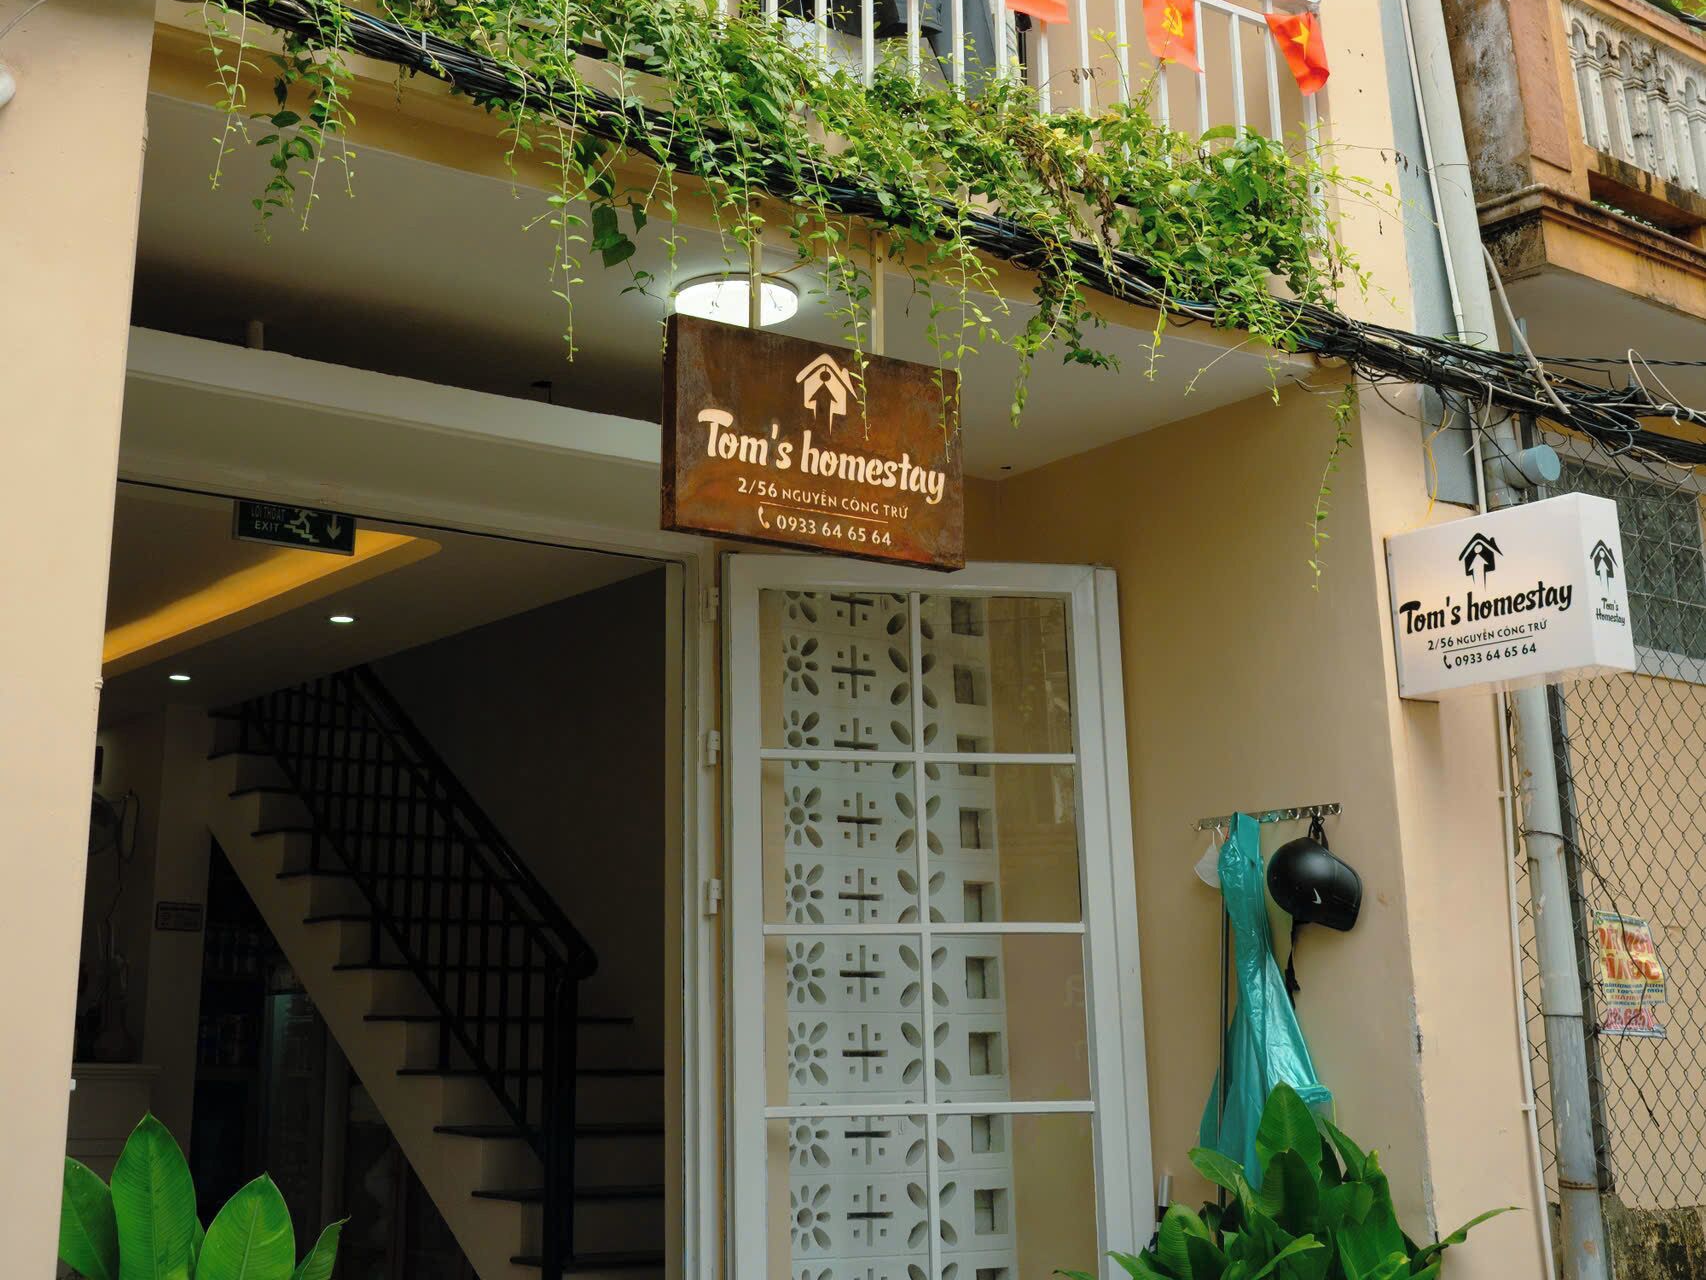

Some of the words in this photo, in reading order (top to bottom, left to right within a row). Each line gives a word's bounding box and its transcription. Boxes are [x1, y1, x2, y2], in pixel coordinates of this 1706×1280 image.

[697, 408, 794, 470] Tom's
[800, 430, 946, 505] homestay
[737, 477, 778, 499] 2/56
[841, 494, 879, 515] CÔNG
[254, 520, 280, 533] EXIT
[776, 513, 816, 535] 0933
[821, 521, 842, 539] 64
[847, 526, 867, 543] 65
[871, 529, 892, 547] 64
[1399, 596, 1461, 635] Tom's
[1467, 581, 1573, 622] homestay
[1601, 597, 1619, 612] Tom's
[1427, 636, 1454, 651] 2/56
[1455, 652, 1482, 667] 0933
[1486, 649, 1501, 661] 64
[1504, 645, 1518, 658] 65
[1521, 642, 1537, 655] 64
